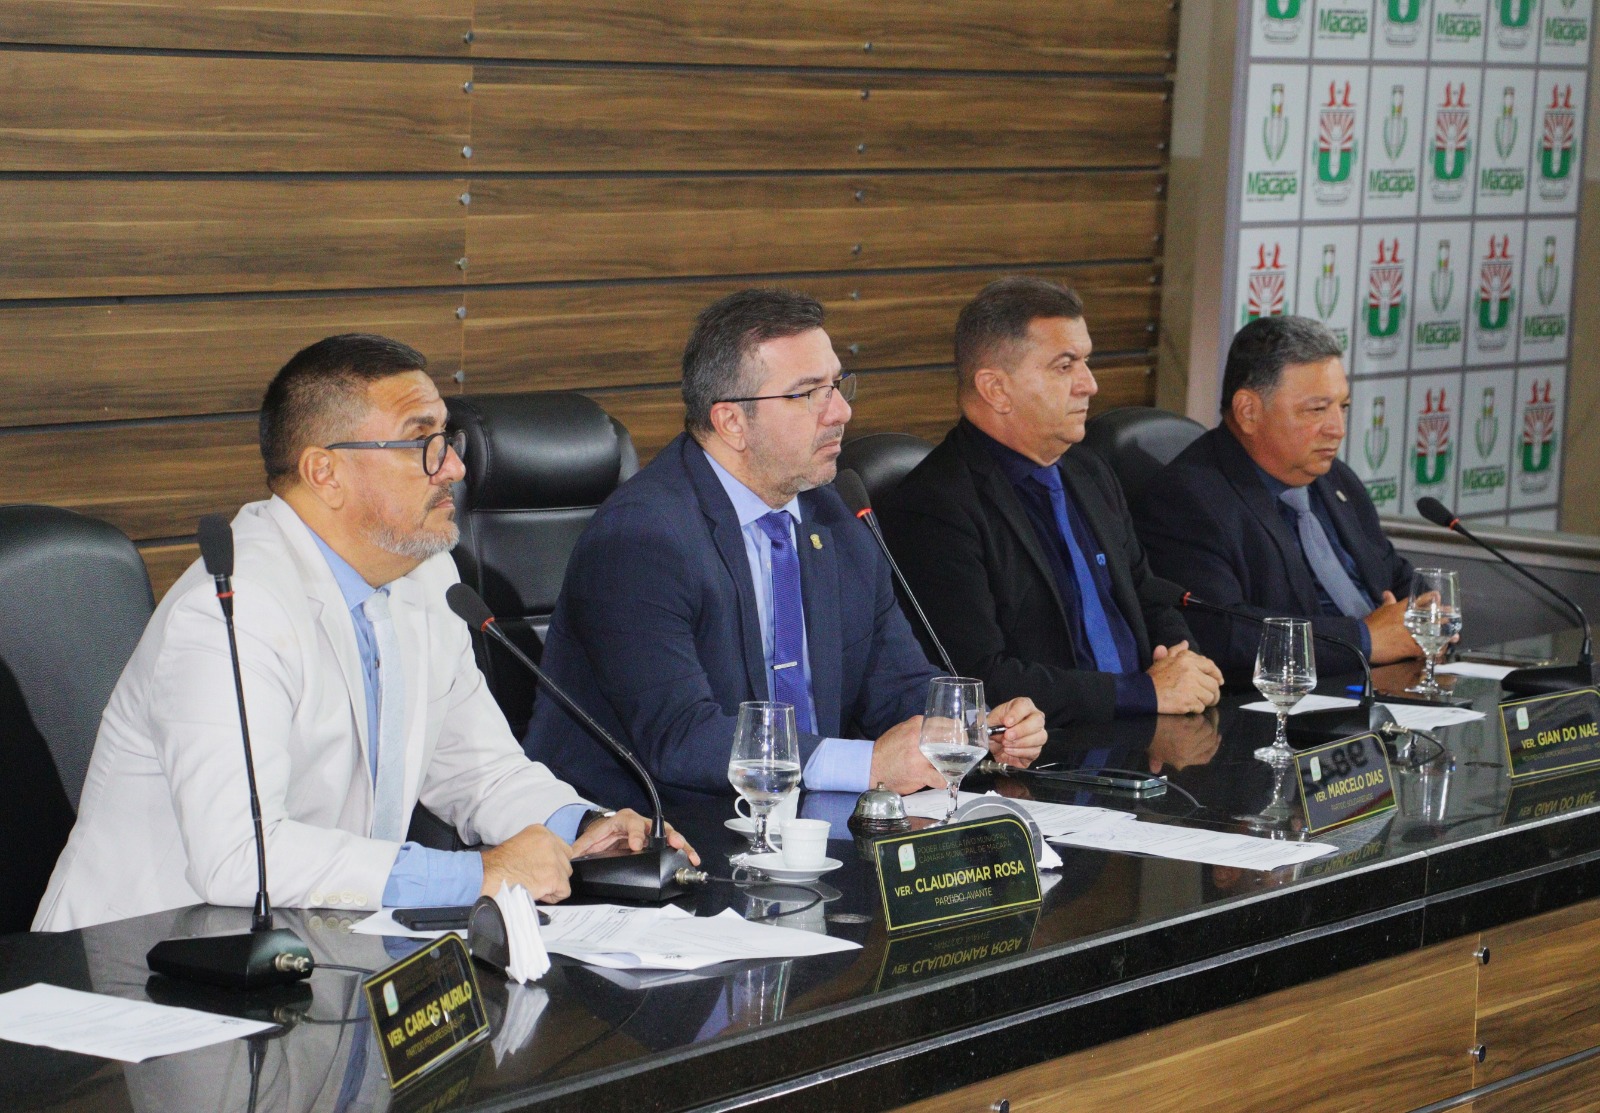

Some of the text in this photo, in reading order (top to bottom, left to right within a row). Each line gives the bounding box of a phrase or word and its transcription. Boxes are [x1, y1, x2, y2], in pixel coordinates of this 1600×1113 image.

[1537, 730, 1561, 746] GIAN
[1563, 726, 1577, 742] DO
[1579, 722, 1599, 738] NAE
[1327, 775, 1365, 798] MARCELO
[1365, 769, 1384, 787] DIAS
[894, 859, 1026, 897] VER. CLAUDIOMAR ROSA
[934, 886, 993, 906] PARTIDO AVANTE
[405, 1000, 441, 1038] CARLOS
[440, 980, 473, 1013] MURILO
